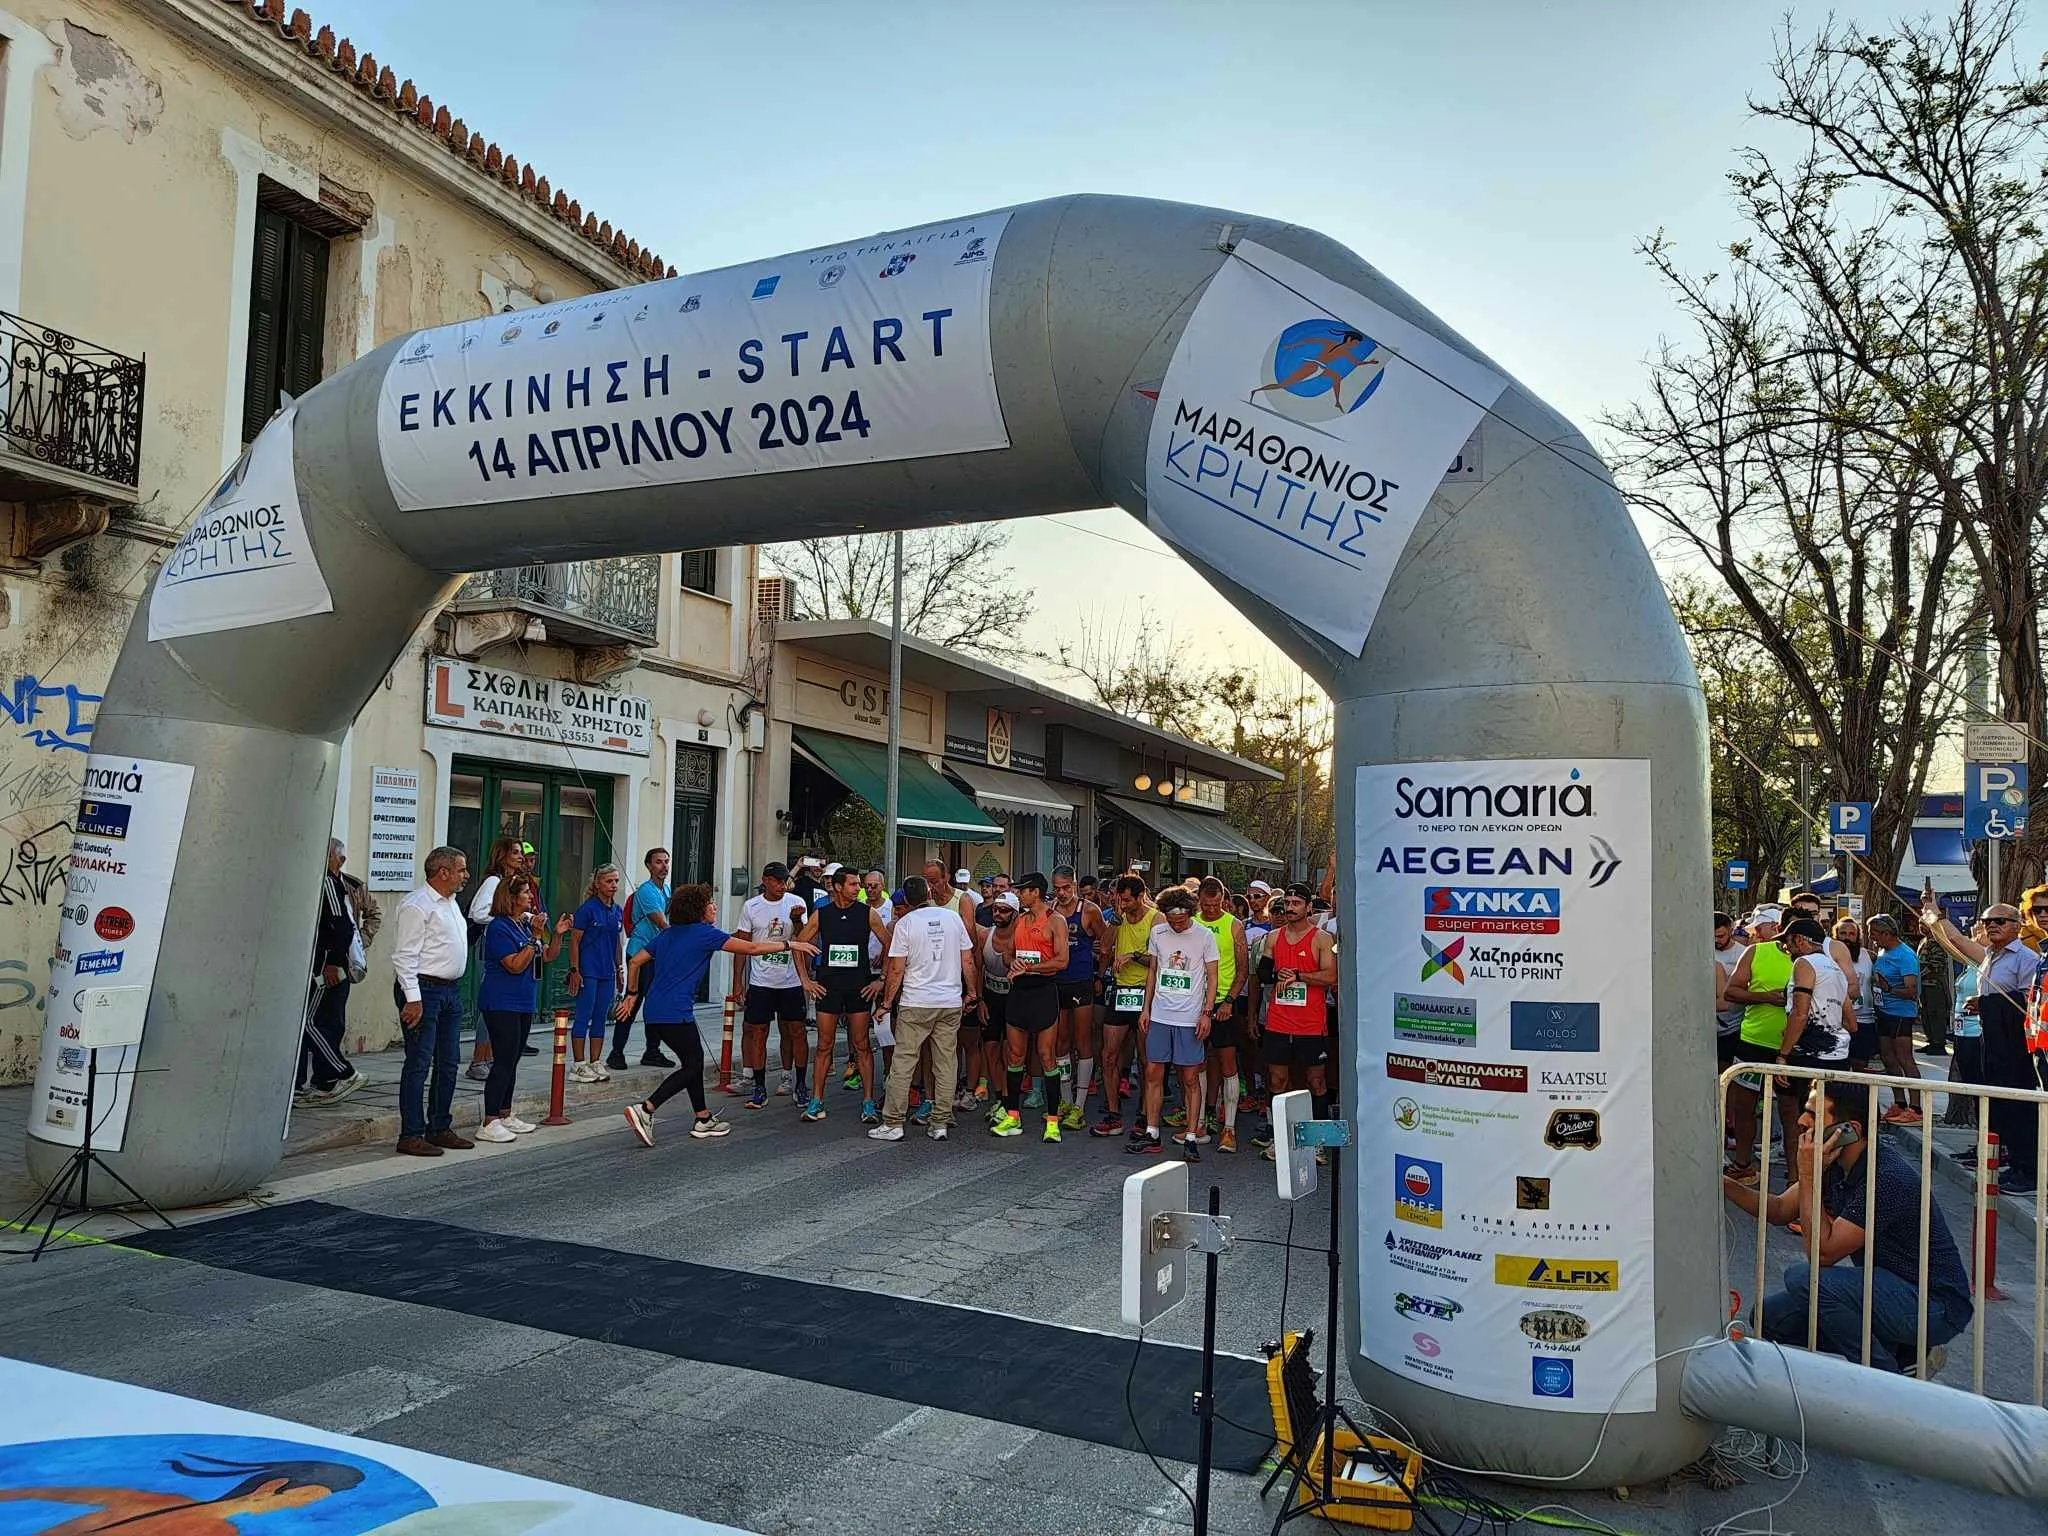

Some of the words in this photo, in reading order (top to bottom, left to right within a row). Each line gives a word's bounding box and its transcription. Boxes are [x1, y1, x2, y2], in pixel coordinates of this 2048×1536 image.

[960, 250, 985, 260] AIMS
[400, 354, 669, 432] ΕΚΚΙΝΗΣΗ
[738, 308, 953, 384] START
[469, 437, 516, 481] 14
[528, 407, 734, 477] ΑΠΡΙΛΙΟΥ
[751, 390, 871, 449] 2024
[1174, 398, 1400, 512] ΜΑΡΑΘΩΝΙΟΣ
[1166, 431, 1382, 557] ΚΡΗΤΗΣ
[165, 528, 292, 581] ΚΡΗΤΗΣ
[435, 665, 465, 718] L
[467, 669, 549, 702] ΣΧΟΛΗ
[561, 687, 647, 721] ΟΔΗΓΩΝ
[473, 696, 563, 725] ΚΑΠΑΚΗΣ
[571, 713, 644, 738] ΧΡΗΣΤΟΣ
[526, 723, 556, 738] ΤΗΛ.
[561, 729, 595, 744] 53553
[1980, 767, 2016, 802] P
[1840, 806, 1861, 830] P
[88, 823, 123, 836] LINES
[1418, 824, 1429, 832] ΤΟ
[1432, 824, 1456, 832] ΝΕΡΟ
[1459, 824, 1478, 832] ΤΩΝ
[1482, 824, 1523, 832] ΛΕΥΚΩΝ
[1527, 824, 1562, 832] ΟΡΕΩΝ
[1376, 847, 1572, 875] AEGEAN
[1431, 886, 1552, 913] SYNKA
[1438, 920, 1480, 931] super
[1481, 920, 1545, 931] markets
[80, 957, 118, 971] TEMENIA
[766, 953, 785, 963] 252
[834, 952, 853, 962] 228
[1469, 947, 1564, 967] Χαζηράκης
[1470, 966, 1496, 978] ALL
[1499, 967, 1517, 979] TO
[1521, 967, 1563, 980] PRINT
[1166, 977, 1185, 988] 330
[1121, 996, 1139, 1006] 339
[1281, 989, 1300, 1000] 185
[1410, 1003, 1455, 1014] ΘΩΜΑΔΑΚΗΣ
[1403, 1031, 1466, 1045] www.thomadakis.gr
[1536, 1029, 1577, 1038] AIOLOS
[1426, 1073, 1482, 1087] ΞΥΛΕΙΑ
[1541, 1072, 1607, 1085] KAATSU
[1556, 1120, 1595, 1135] Orsero
[1400, 1197, 1435, 1215] FREE
[1407, 1212, 1429, 1223] LEMON
[1461, 1214, 1515, 1227] ΚΤΗΜΑ
[1532, 1221, 1611, 1231] ΛΟΥΠΑΚΗ
[1398, 1237, 1483, 1261] ΧΡΙΣΤΟΔΟΥΛΑΚΗΣ
[1398, 1244, 1442, 1260] ΑΝΤΩΝΙΟΥ
